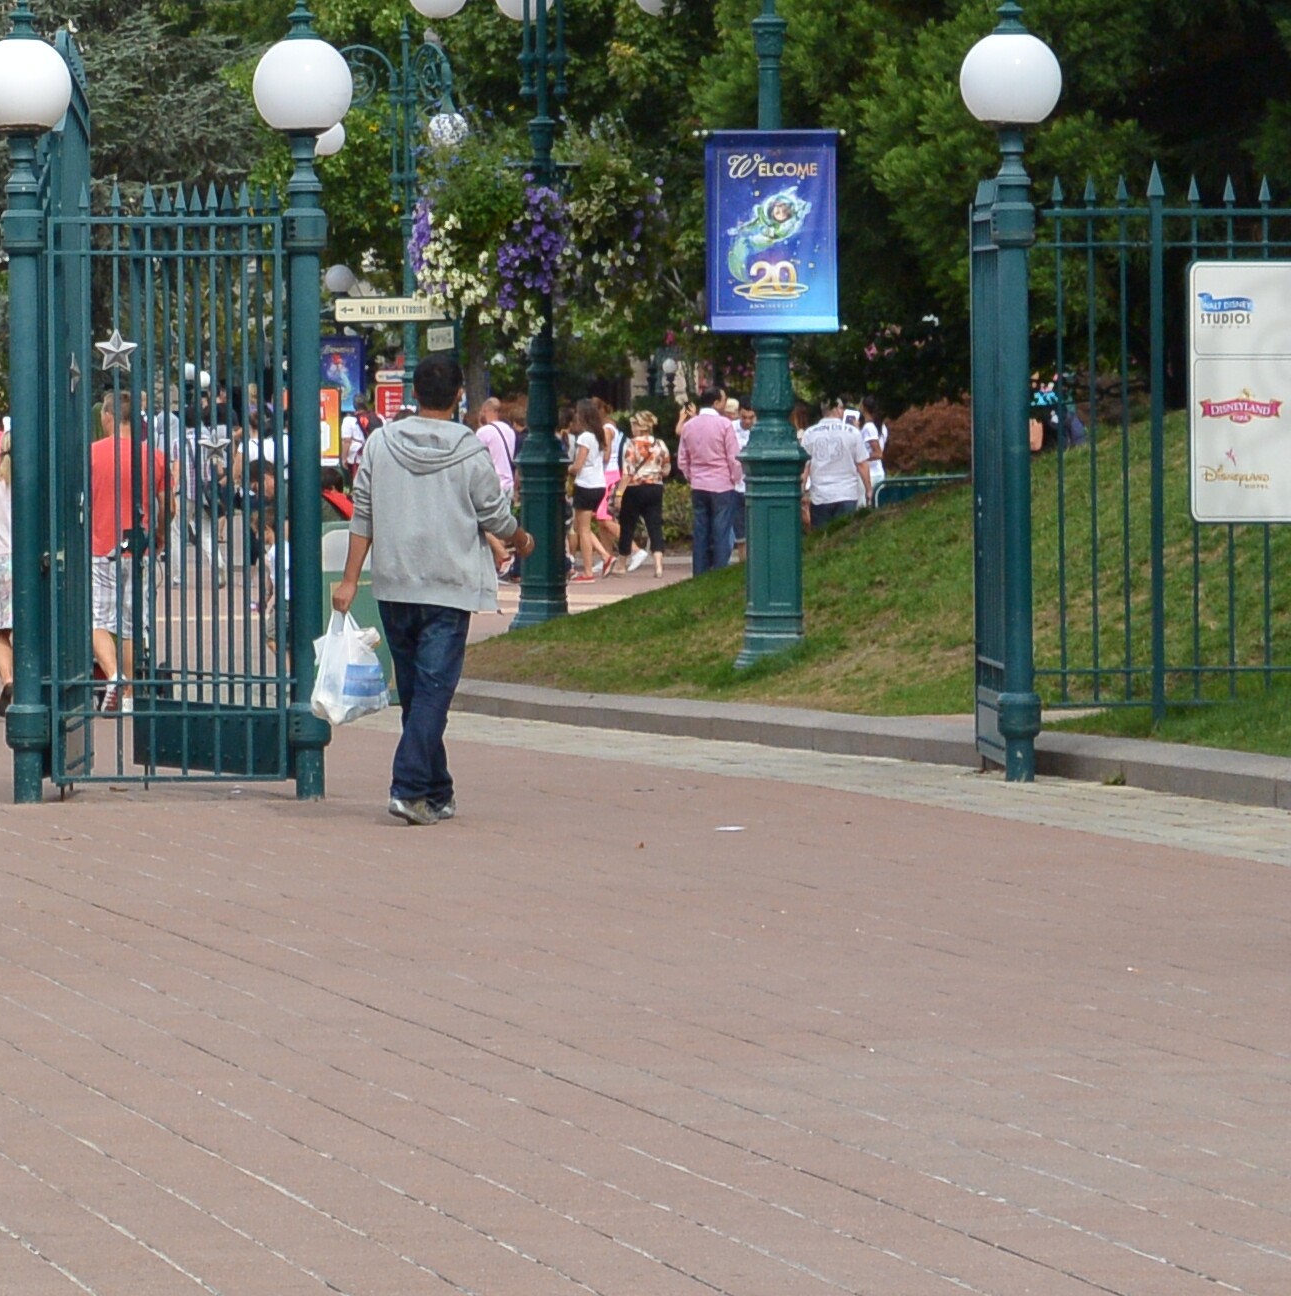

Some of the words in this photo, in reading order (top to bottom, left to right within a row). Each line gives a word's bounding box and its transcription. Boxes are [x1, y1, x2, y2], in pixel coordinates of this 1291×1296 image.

[749, 260, 798, 295] 20
[1200, 312, 1251, 325] STUDIOS
[1210, 401, 1271, 416] DISNEYLAND
